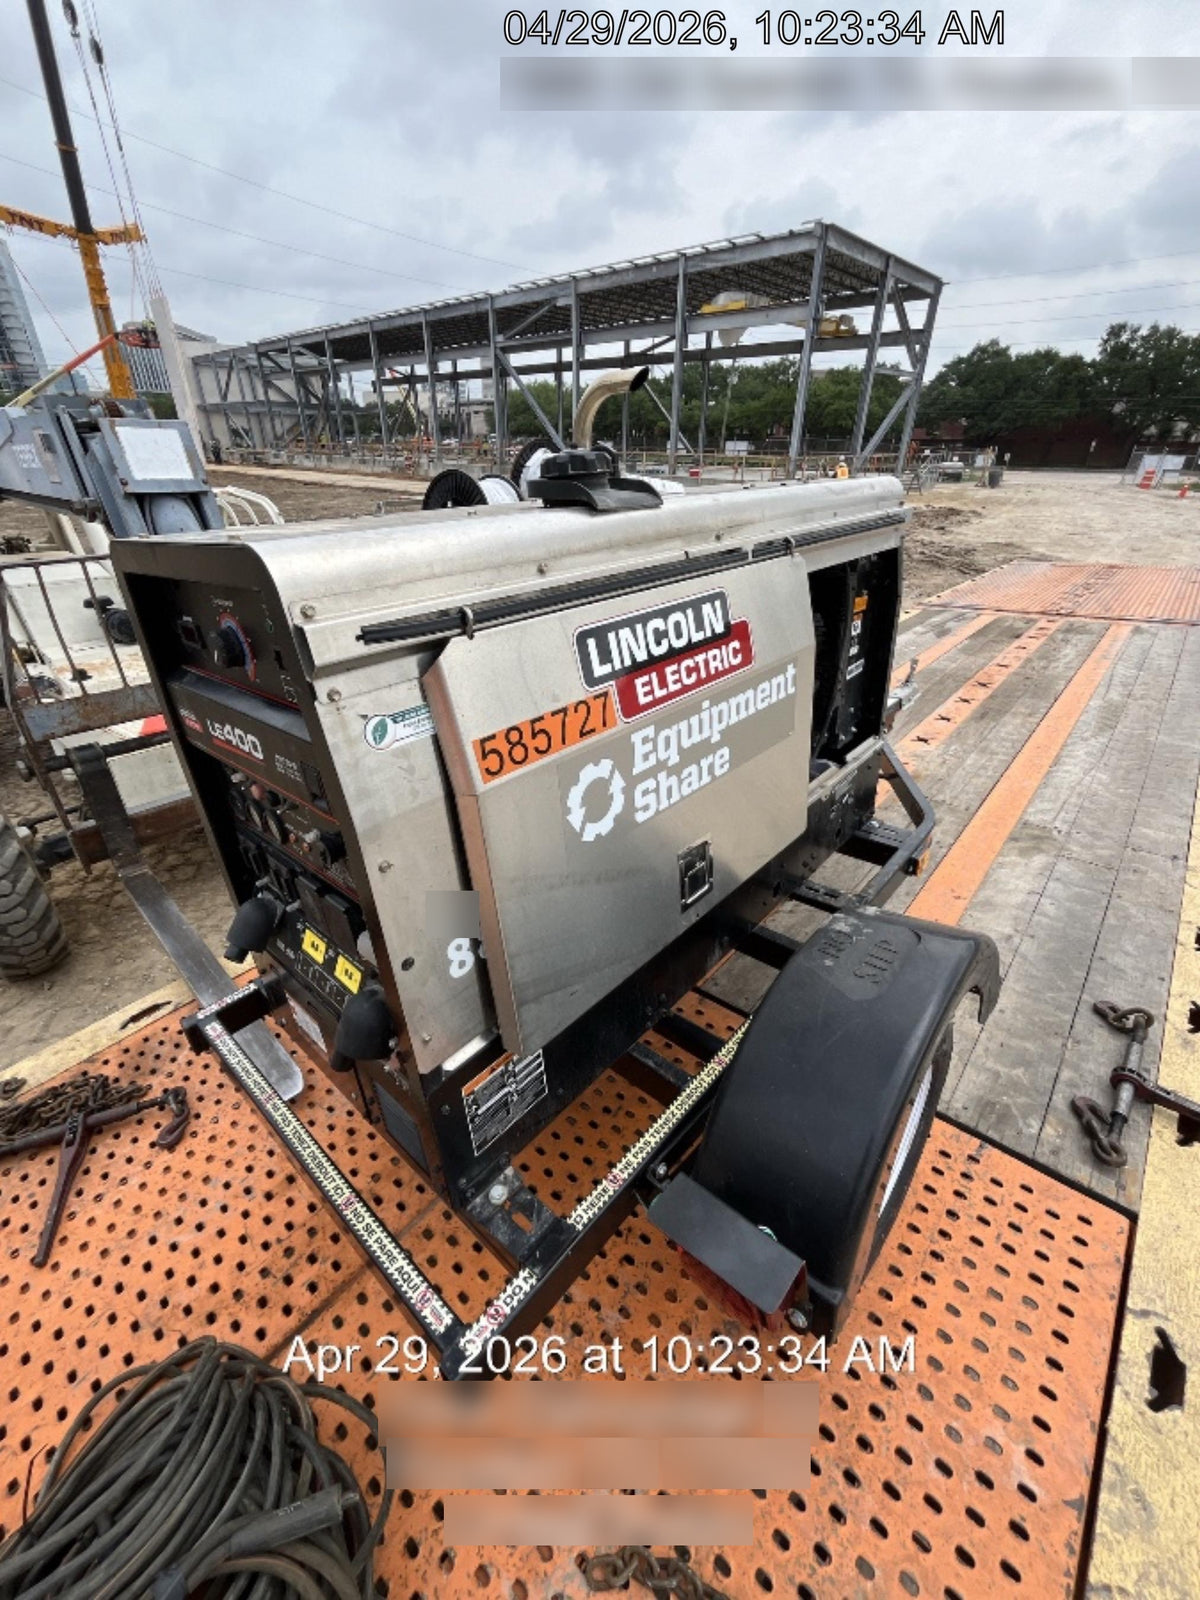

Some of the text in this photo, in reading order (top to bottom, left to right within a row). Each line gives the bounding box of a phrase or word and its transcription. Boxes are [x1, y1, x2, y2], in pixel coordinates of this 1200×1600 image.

[586, 600, 725, 677] LINCOLN
[634, 640, 742, 705] ELECTRIC
[479, 691, 610, 777] 585727
[630, 662, 796, 776] Equipment
[633, 746, 731, 824] Share
[631, 1138, 652, 1159] PAS
[349, 1207, 365, 1223] NO
[361, 1222, 376, 1238] SE
[371, 1236, 398, 1267] PARE
[501, 1282, 524, 1306] DO
